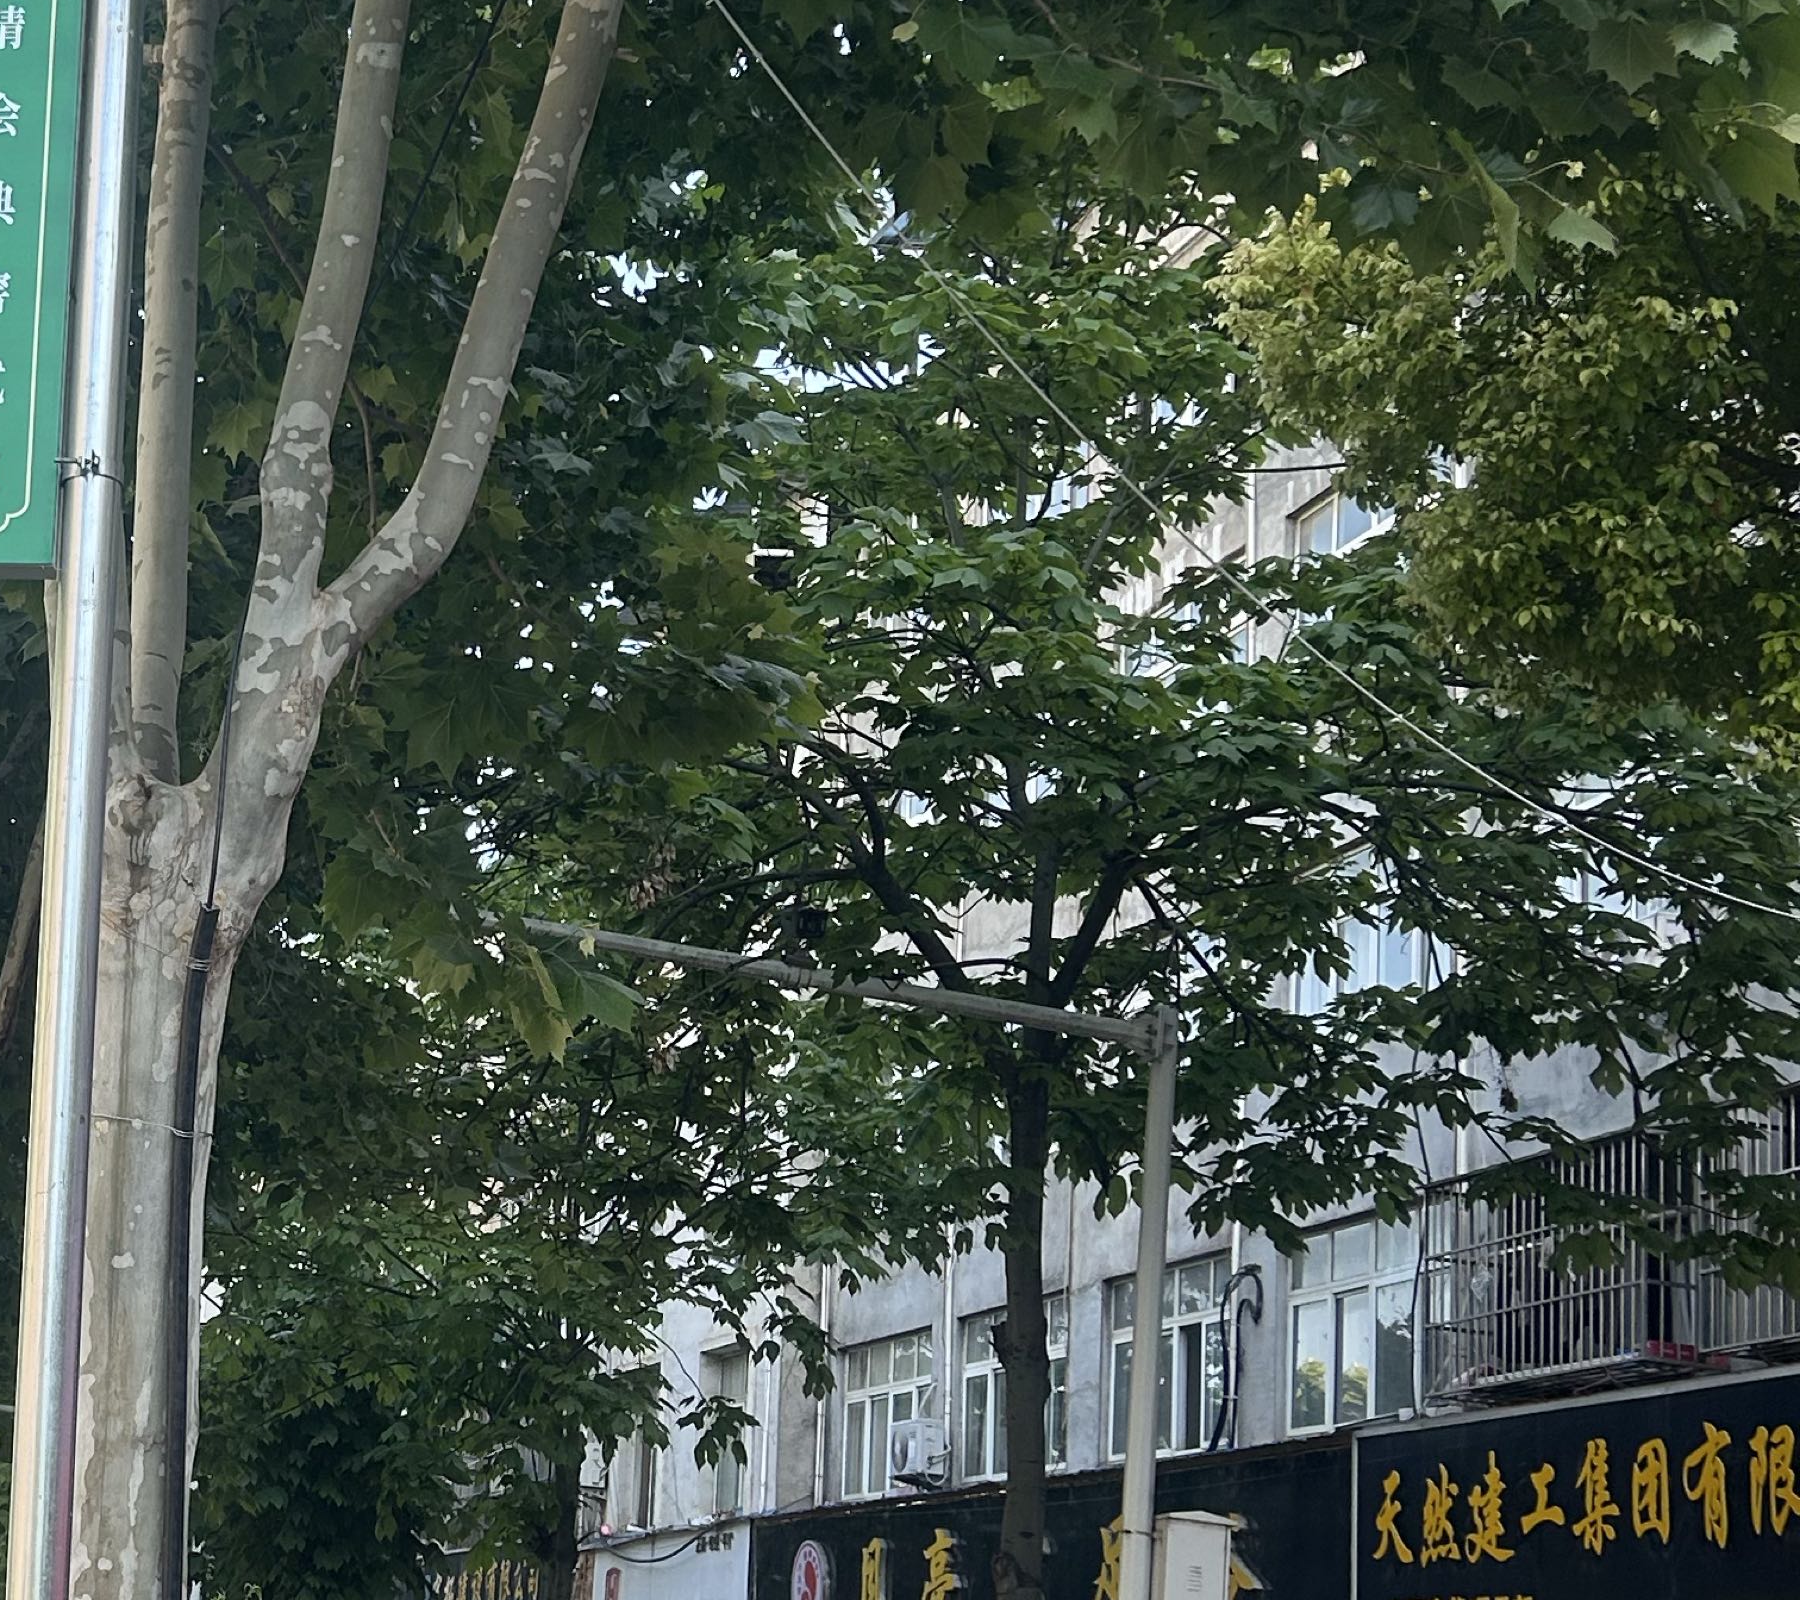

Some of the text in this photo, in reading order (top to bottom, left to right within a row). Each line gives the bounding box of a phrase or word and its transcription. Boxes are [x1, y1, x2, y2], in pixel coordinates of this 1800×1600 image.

[1372, 1421, 1800, 1568] 天然建工集团有限
